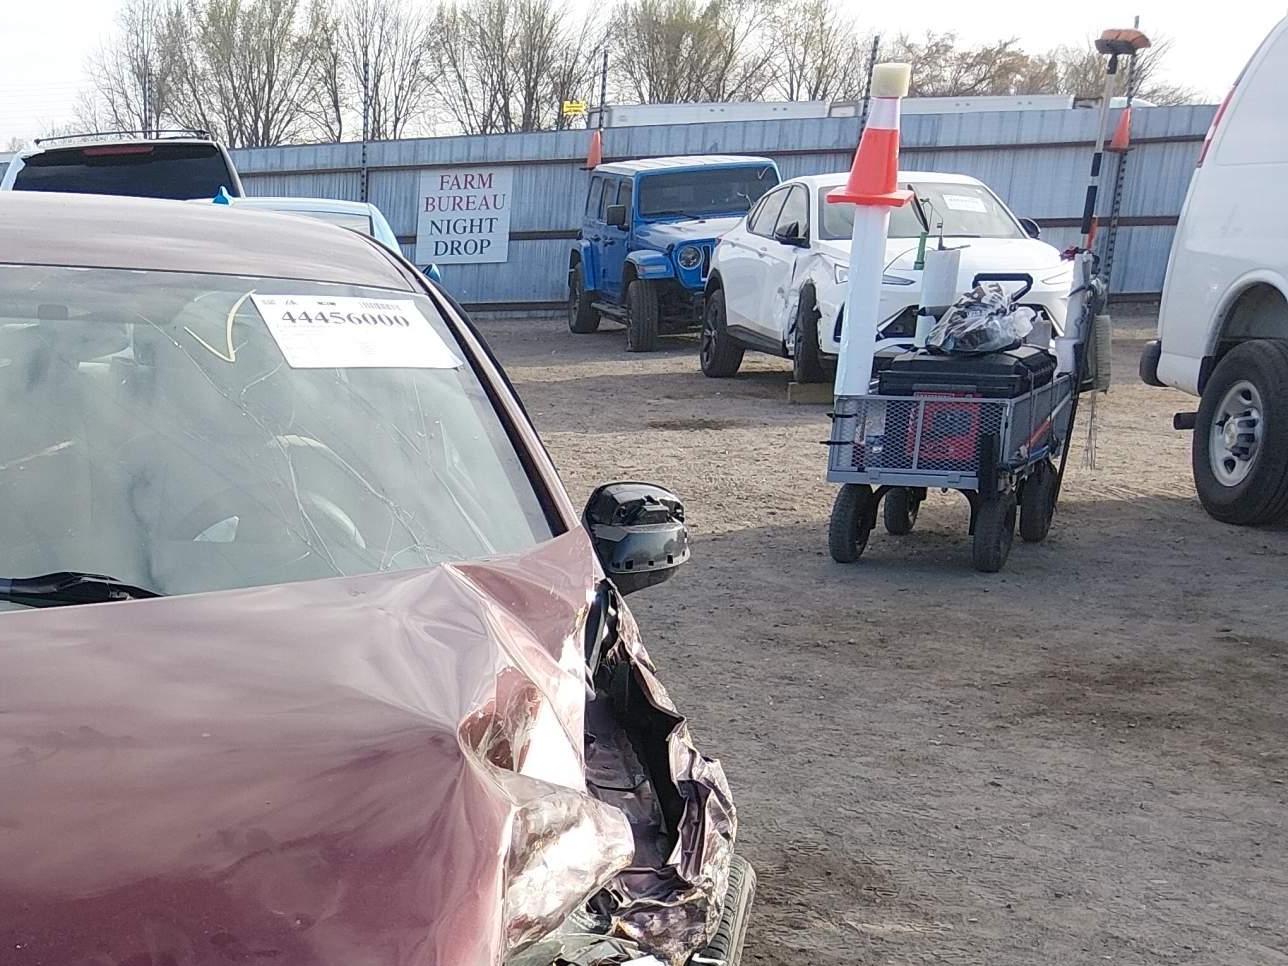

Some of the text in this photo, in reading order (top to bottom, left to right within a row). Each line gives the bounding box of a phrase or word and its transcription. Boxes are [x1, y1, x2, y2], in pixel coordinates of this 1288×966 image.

[439, 172, 495, 191] FARM
[424, 193, 507, 213] BUREAU
[429, 217, 499, 236] NIGHT
[433, 238, 492, 257] DROP
[281, 310, 411, 328] 44456000
